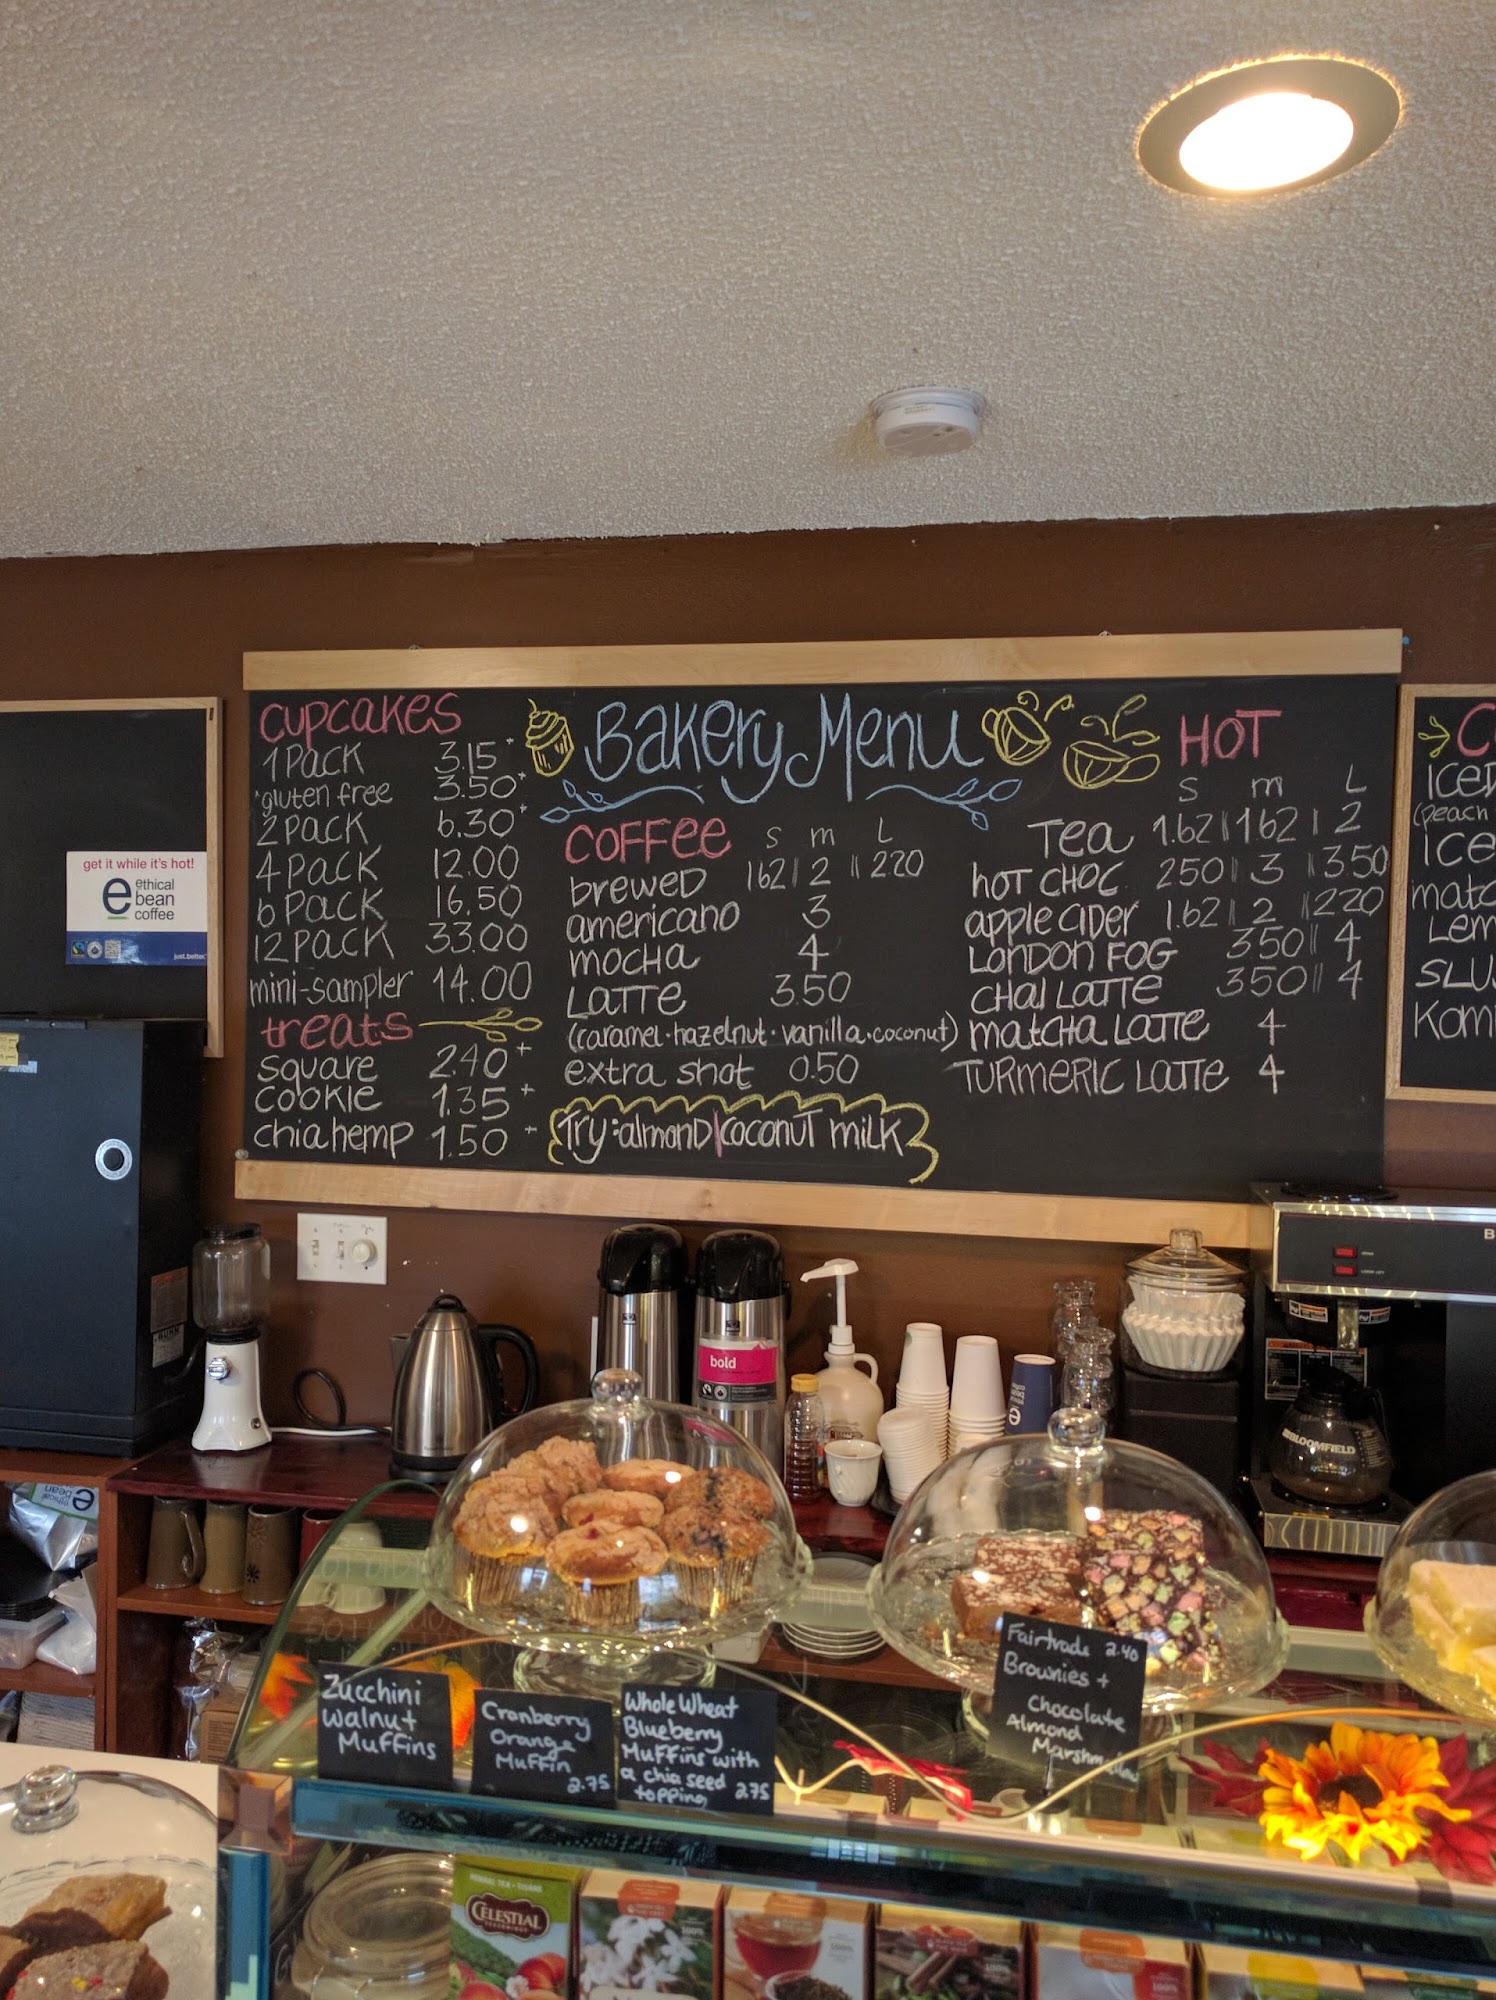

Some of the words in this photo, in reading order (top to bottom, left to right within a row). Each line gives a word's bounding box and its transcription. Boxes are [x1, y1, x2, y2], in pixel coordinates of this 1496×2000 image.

[785, 692, 985, 802] Menu
[1180, 709, 1282, 768] HOT
[1457, 702, 1496, 758] C
[262, 747, 277, 782] 1
[1345, 763, 1367, 792] L
[261, 783, 330, 817] gluten
[337, 782, 393, 807] free
[257, 815, 278, 846] 2
[878, 816, 893, 843] L
[1027, 818, 1135, 859] Tea
[83, 858, 102, 872] get
[105, 858, 113, 869] it
[116, 858, 147, 870] while
[150, 858, 167, 869] it's
[171, 858, 194, 869] hot!
[256, 850, 281, 893] 4
[434, 845, 519, 880] 12.00
[809, 856, 831, 886] 2
[135, 878, 175, 890] ethical
[135, 891, 175, 906] bean
[134, 908, 175, 921] coffee
[257, 898, 275, 928] 6
[436, 884, 523, 920] 16.50
[801, 894, 831, 929] 3
[425, 921, 528, 953] 33.00
[566, 901, 741, 944] americano
[964, 901, 1054, 949] apple
[255, 932, 288, 963] 12
[797, 933, 830, 972] 4
[1106, 937, 1179, 972] FOG
[1334, 919, 1361, 963] 4
[250, 966, 414, 1009] mini-sampler
[432, 960, 533, 1004] 14.00
[1338, 960, 1363, 1000] 4
[1415, 953, 1496, 992] SLU
[260, 1011, 414, 1050] treats
[1257, 1008, 1286, 1046] 4
[1414, 1000, 1496, 1041] Kom
[257, 1054, 378, 1096] square
[564, 1057, 667, 1087] extra
[676, 1053, 755, 1090] shot
[789, 1051, 859, 1085] 0.50
[1258, 1054, 1285, 1094] 4
[253, 1118, 330, 1149] chia
[332, 1116, 414, 1160] hemp
[710, 1354, 737, 1369] bold
[1287, 1430, 1356, 1455] BLOOMFIELD
[1007, 1623, 1090, 1657] Fairtrade
[1105, 1641, 1139, 1662] 2.40
[1003, 1651, 1090, 1687] Brownies
[322, 1674, 421, 1706] Zucchini
[624, 1690, 676, 1715] Whole
[678, 1692, 739, 1718] Wheat
[481, 1700, 591, 1742] Cranberry
[1006, 1713, 1083, 1742] Almond
[1027, 1694, 1126, 1733] Chocolate
[490, 1728, 576, 1761] Orange
[623, 1715, 724, 1754] Blueberry
[495, 1752, 571, 1773] Muffin
[712, 1748, 760, 1768] with
[567, 1773, 610, 1793] 2.75
[620, 1767, 636, 1781] a
[643, 1767, 682, 1785] chia
[686, 1773, 726, 1791] seed
[634, 1784, 708, 1810] topping
[471, 1901, 543, 1930] CELESTIAL
